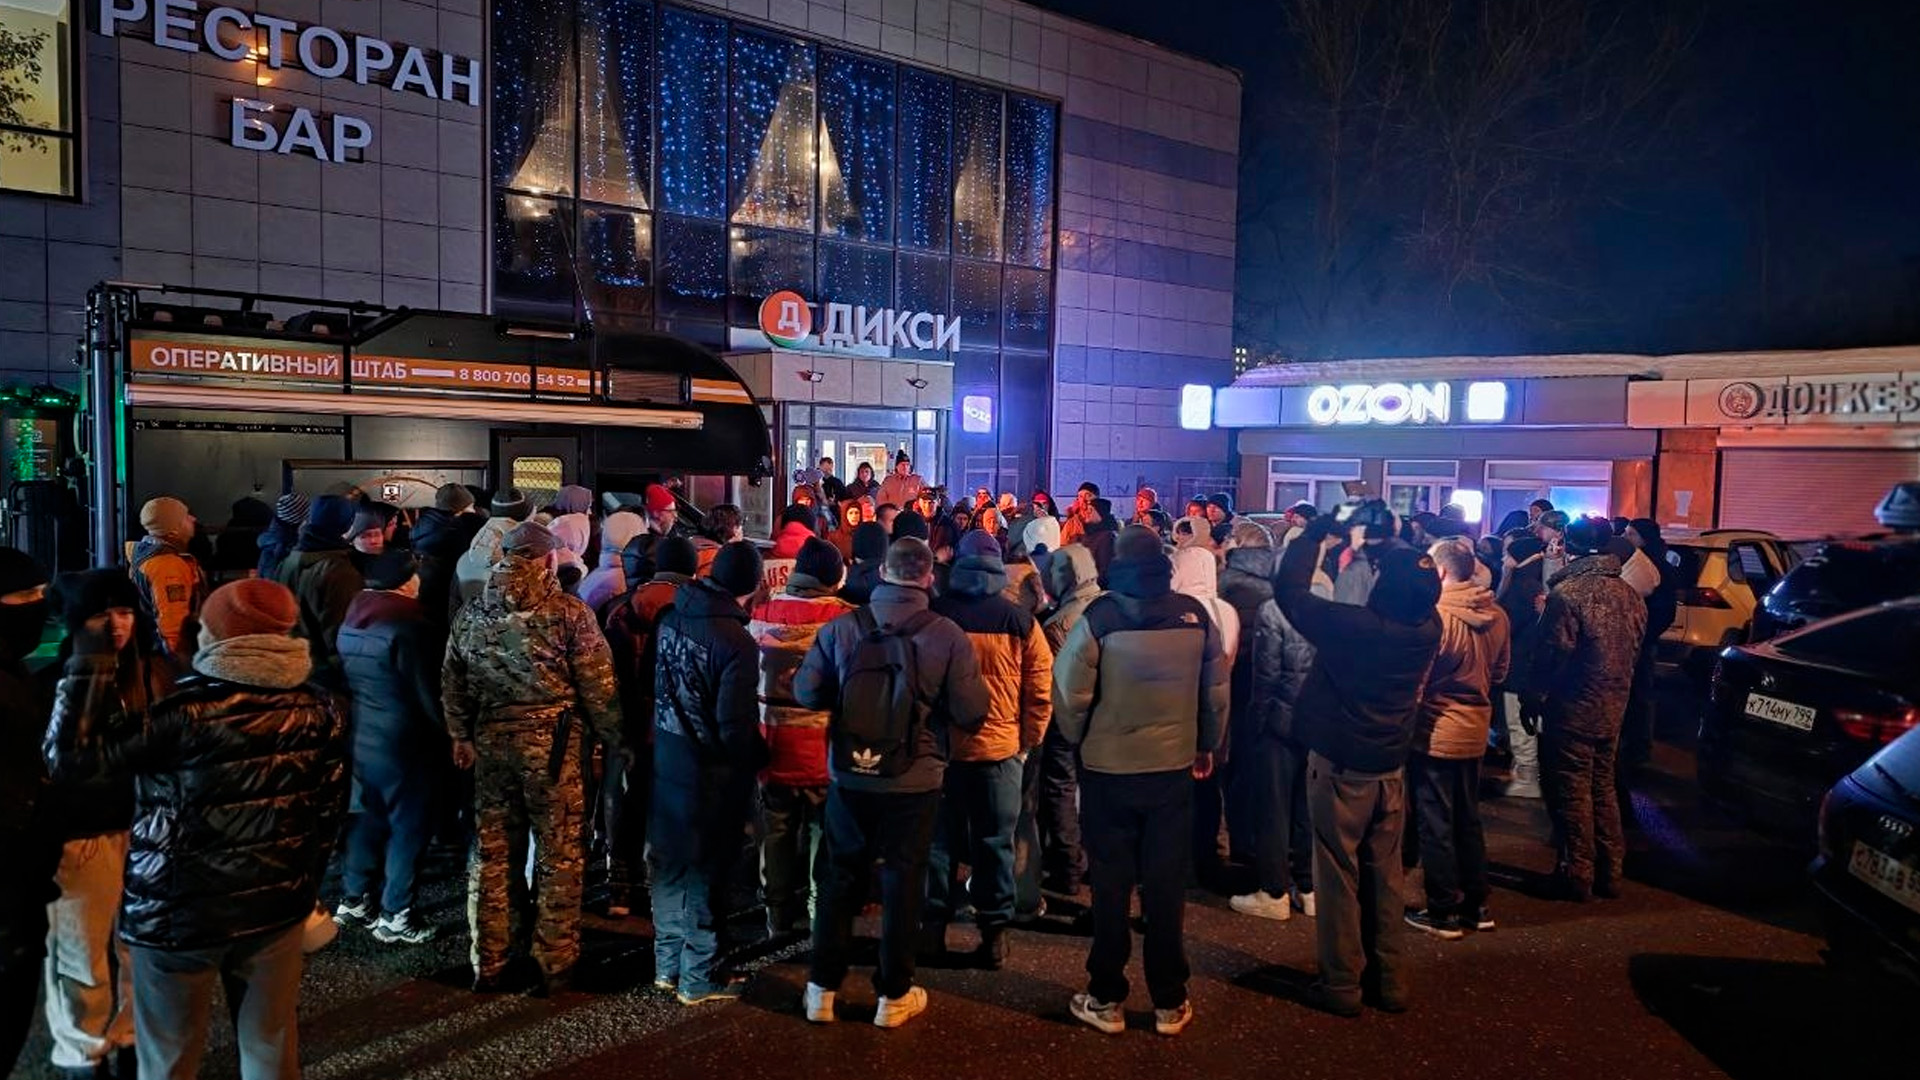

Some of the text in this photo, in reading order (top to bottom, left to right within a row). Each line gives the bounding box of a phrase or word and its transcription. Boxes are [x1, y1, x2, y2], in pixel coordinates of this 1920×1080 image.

[100, 0, 480, 107] РЕСТОРАН
[231, 98, 373, 163] БАР
[778, 301, 961, 352] Д ДИКСИ
[150, 346, 575, 387] ОПЕРАТИВНЫЙ ШТАБ 8 800 700 54 52
[1307, 382, 1451, 425] OZON
[1765, 382, 1838, 417] ДОН
[758, 565, 789, 590] US
